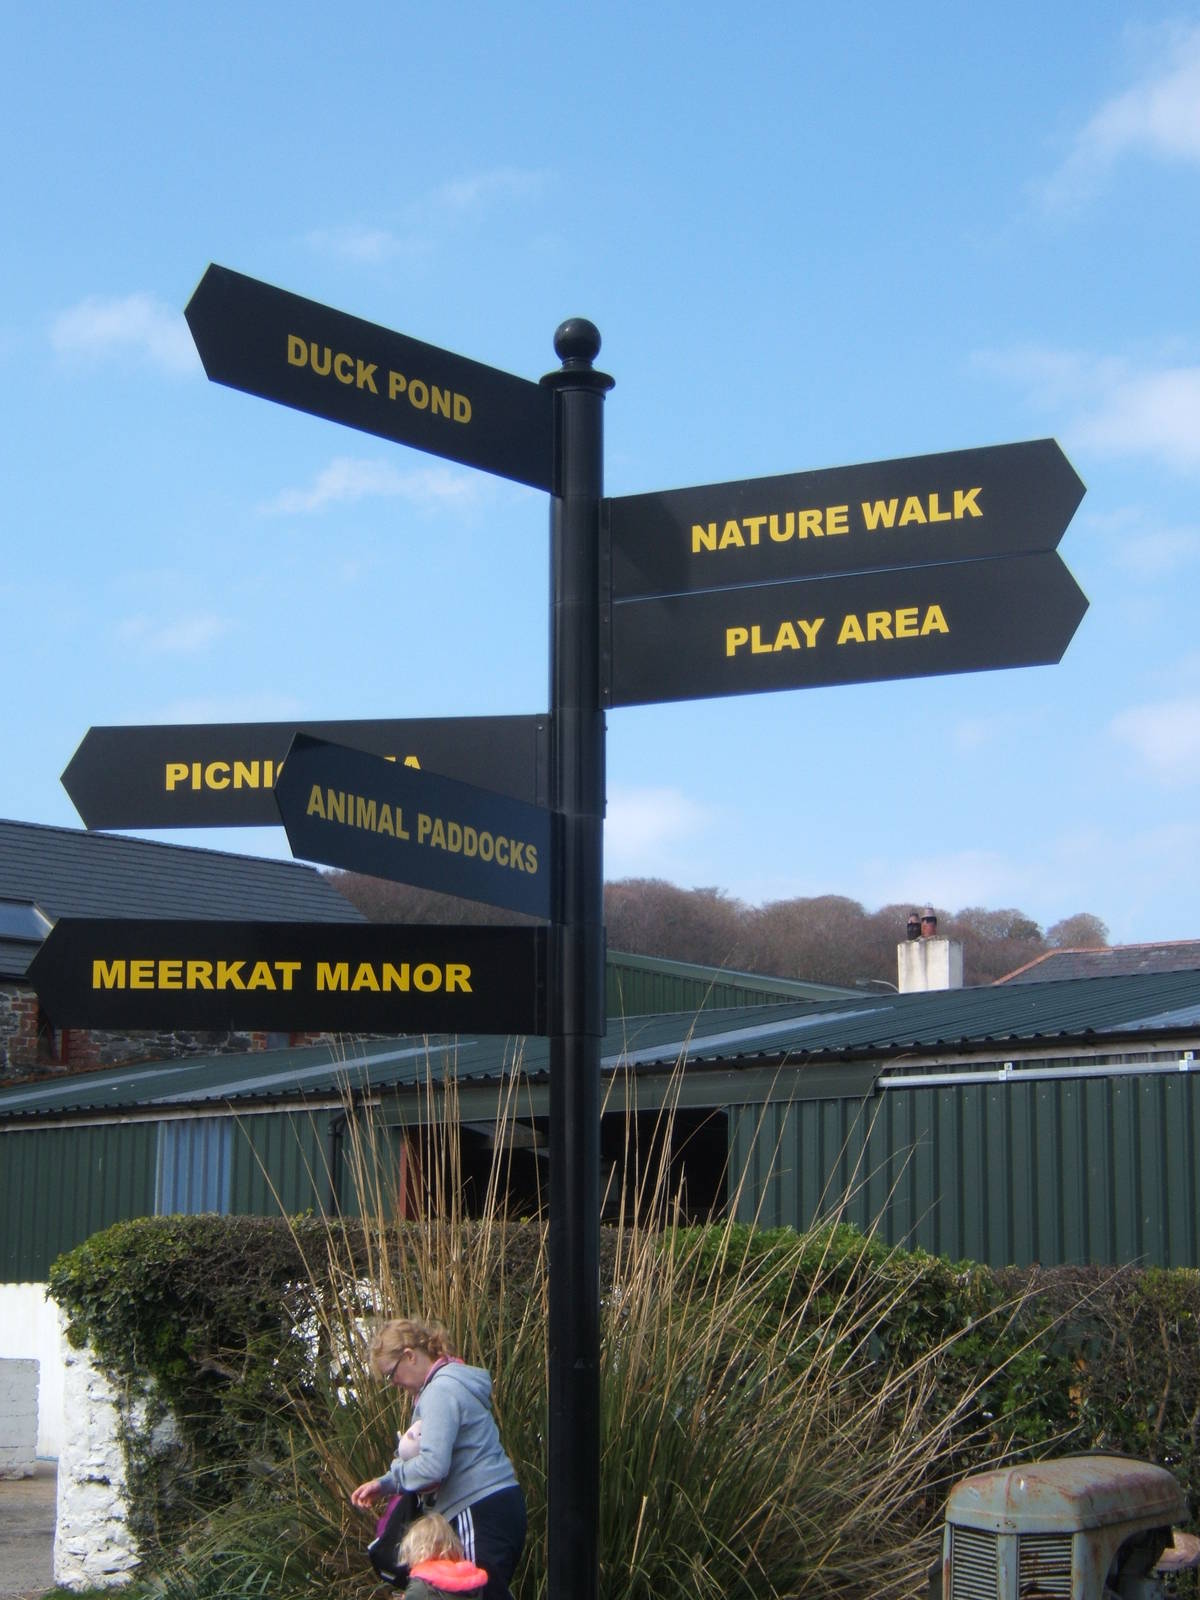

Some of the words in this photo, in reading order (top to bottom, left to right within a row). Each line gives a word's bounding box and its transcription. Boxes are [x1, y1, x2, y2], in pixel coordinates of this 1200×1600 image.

[287, 335, 377, 393] DUCK
[388, 371, 472, 423] POND
[691, 504, 849, 553] NATURE
[861, 487, 983, 532] WALK
[725, 617, 825, 656] PLAY
[837, 604, 950, 645] AREA
[165, 760, 284, 791] PICNI
[307, 784, 410, 838] ANIMAL
[416, 812, 538, 874] PADDOCKS
[92, 960, 302, 991] MEERKAT
[316, 962, 473, 993] MANOR
